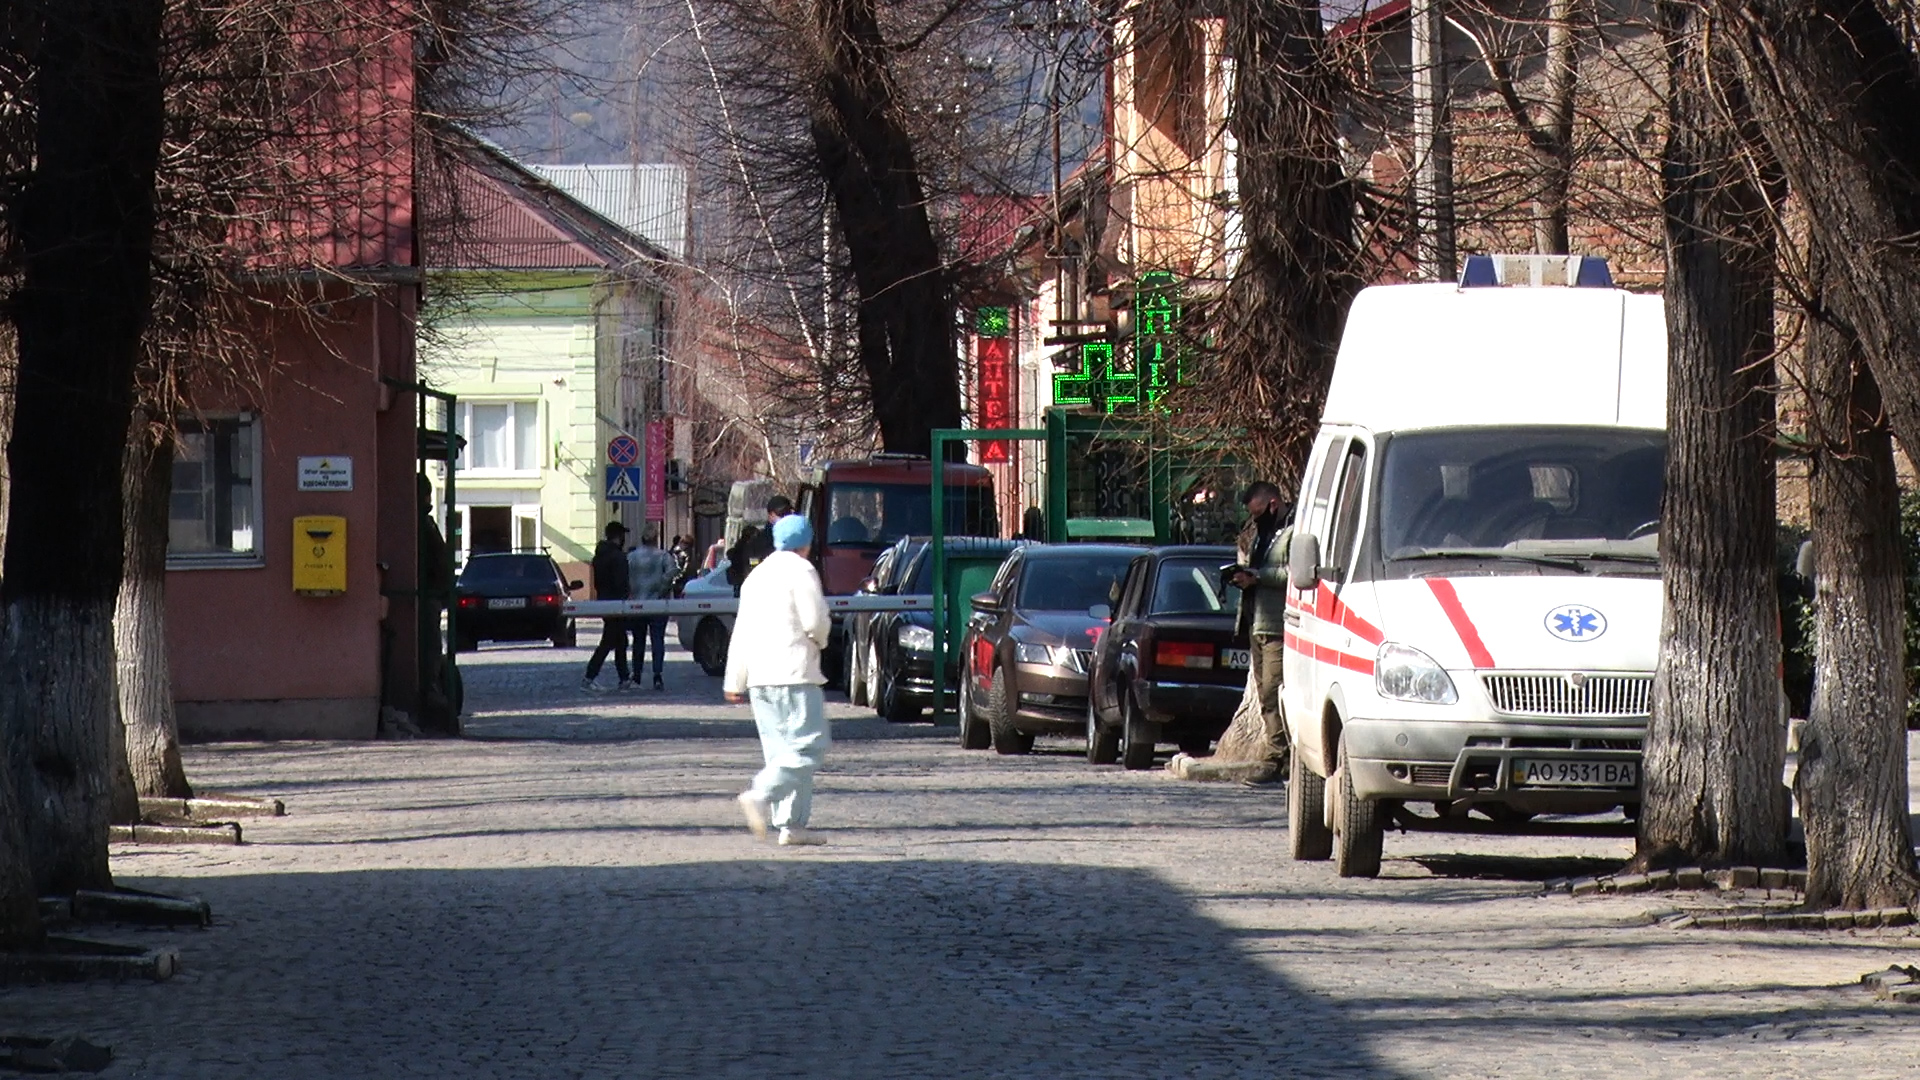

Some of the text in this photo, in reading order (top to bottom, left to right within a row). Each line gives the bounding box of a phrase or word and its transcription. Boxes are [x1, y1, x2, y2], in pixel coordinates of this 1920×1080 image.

[1230, 651, 1249, 665] AO
[1527, 762, 1632, 783] AO 9531 BA
